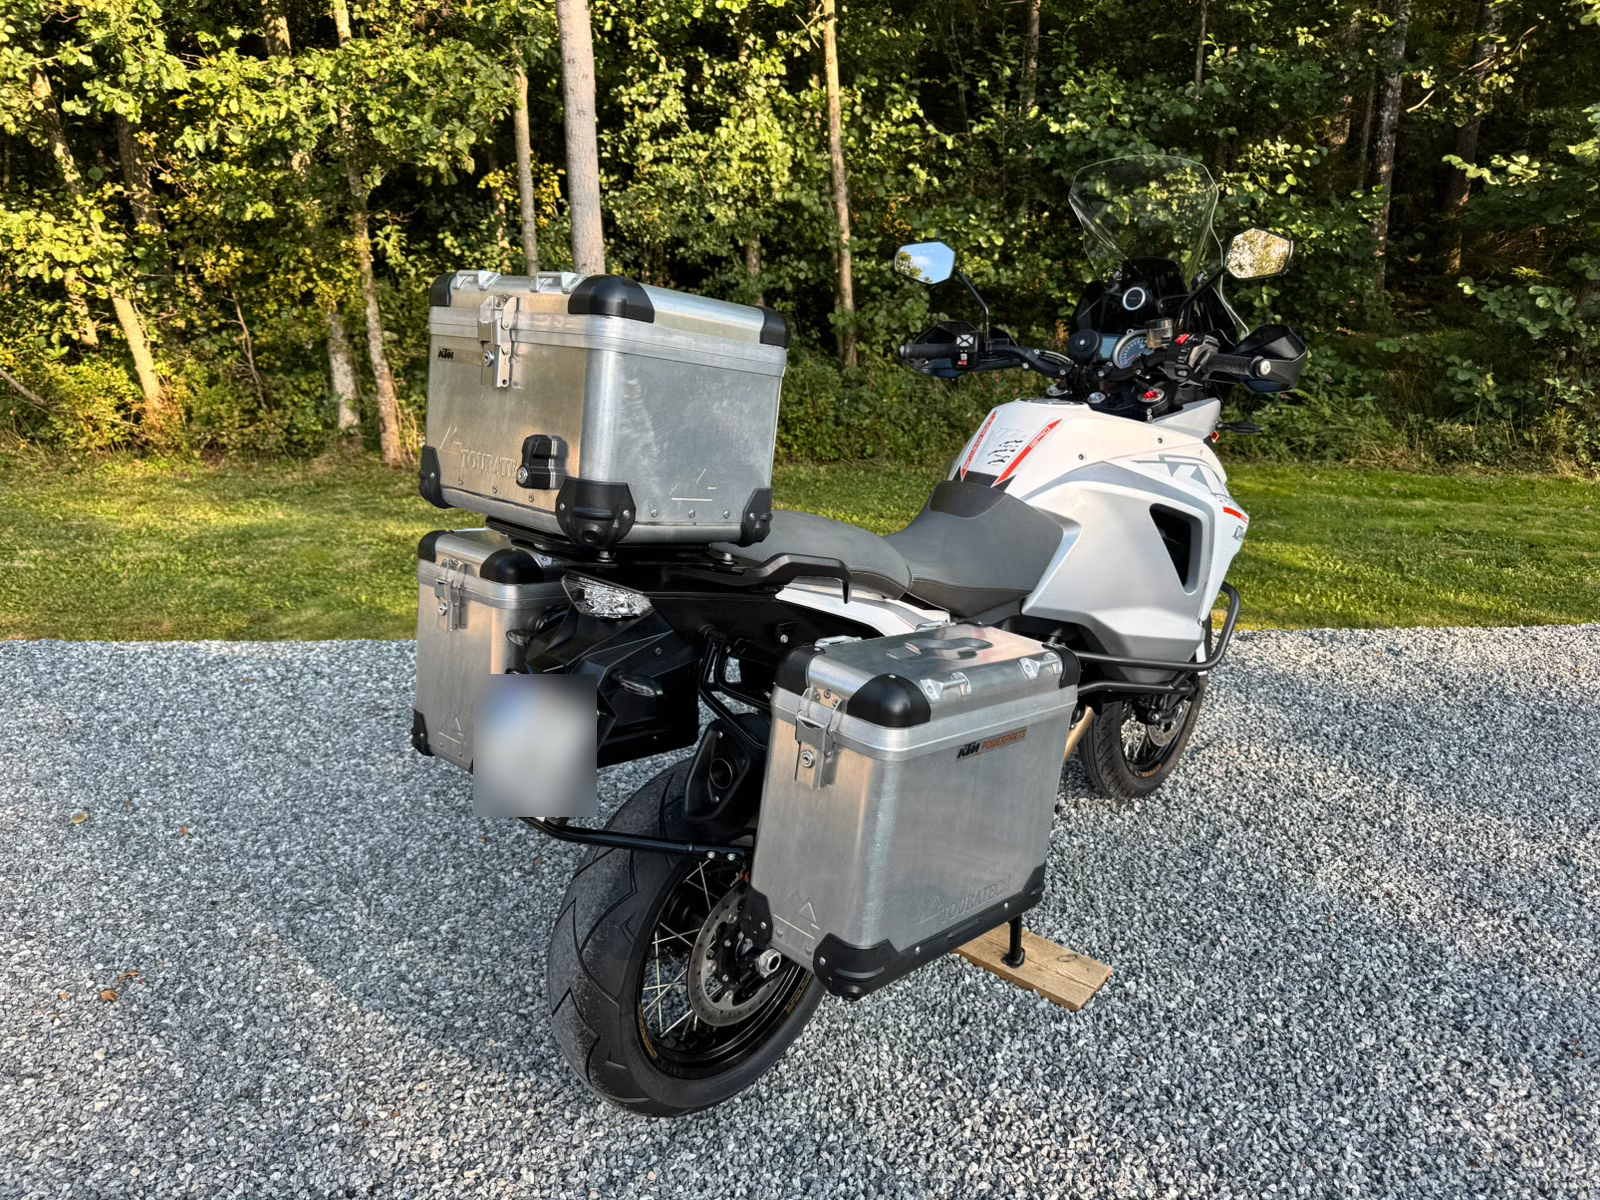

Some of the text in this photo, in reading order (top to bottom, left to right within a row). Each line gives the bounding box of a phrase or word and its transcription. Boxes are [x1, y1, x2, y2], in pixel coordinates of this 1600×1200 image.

[437, 348, 455, 360] KTM
[460, 448, 521, 478] TOURATE
[956, 741, 980, 759] KTM
